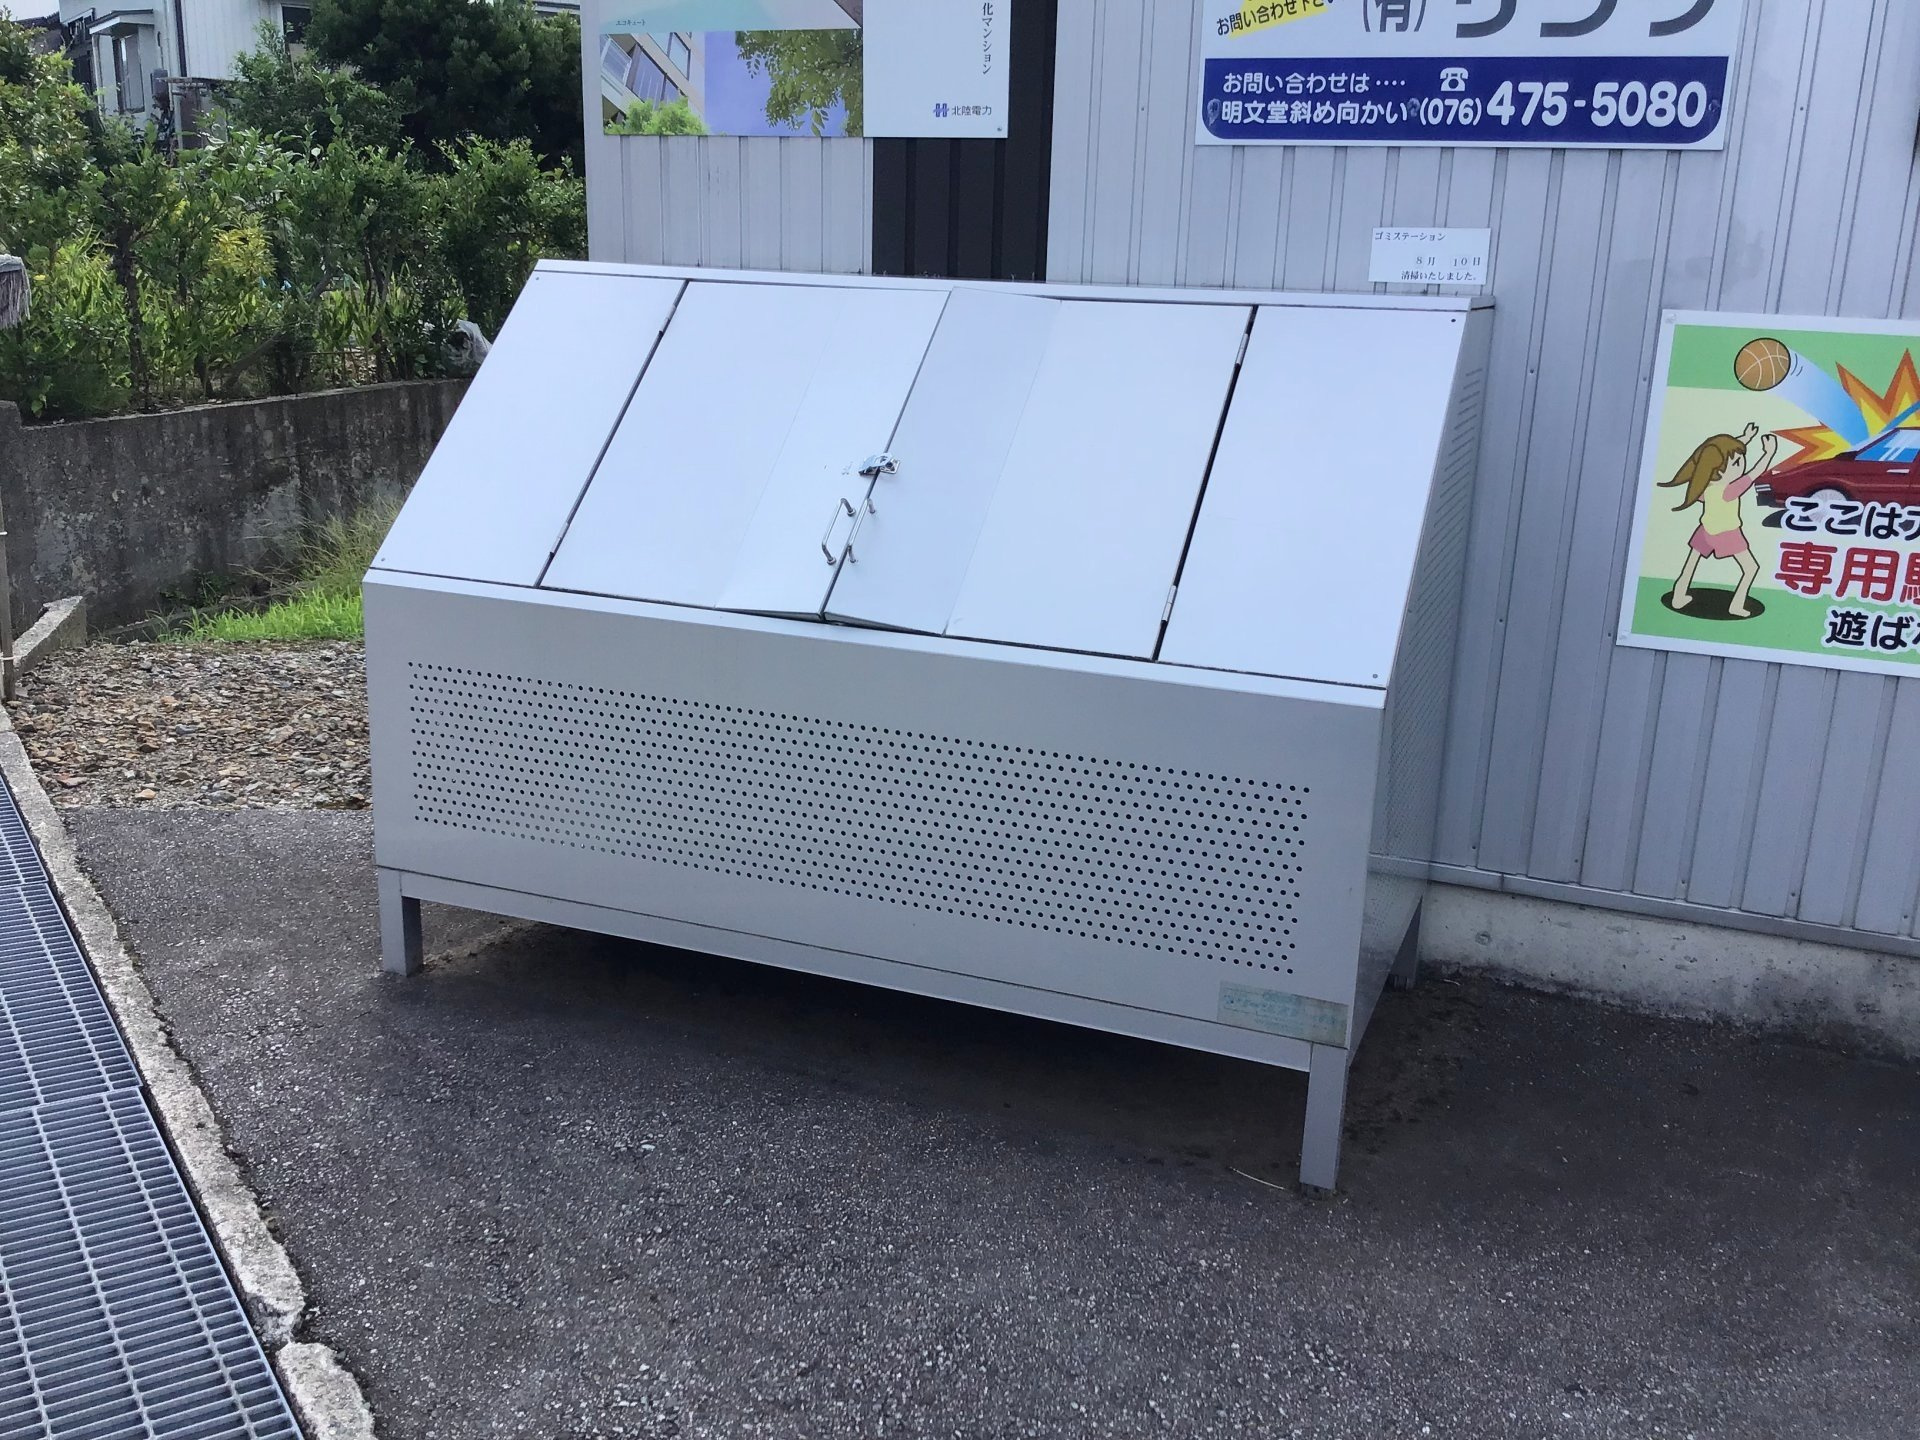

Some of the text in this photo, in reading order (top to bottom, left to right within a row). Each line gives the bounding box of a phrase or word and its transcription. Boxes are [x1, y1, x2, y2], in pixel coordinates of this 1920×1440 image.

[951, 105, 992, 116] 北陸電力
[1221, 100, 1408, 125] 明文堂斜め向かい
[1374, 231, 1447, 241] ゴミステーション
[1401, 270, 1476, 281] 清掃いたしました。
[1825, 609, 1920, 650] 遊ば
